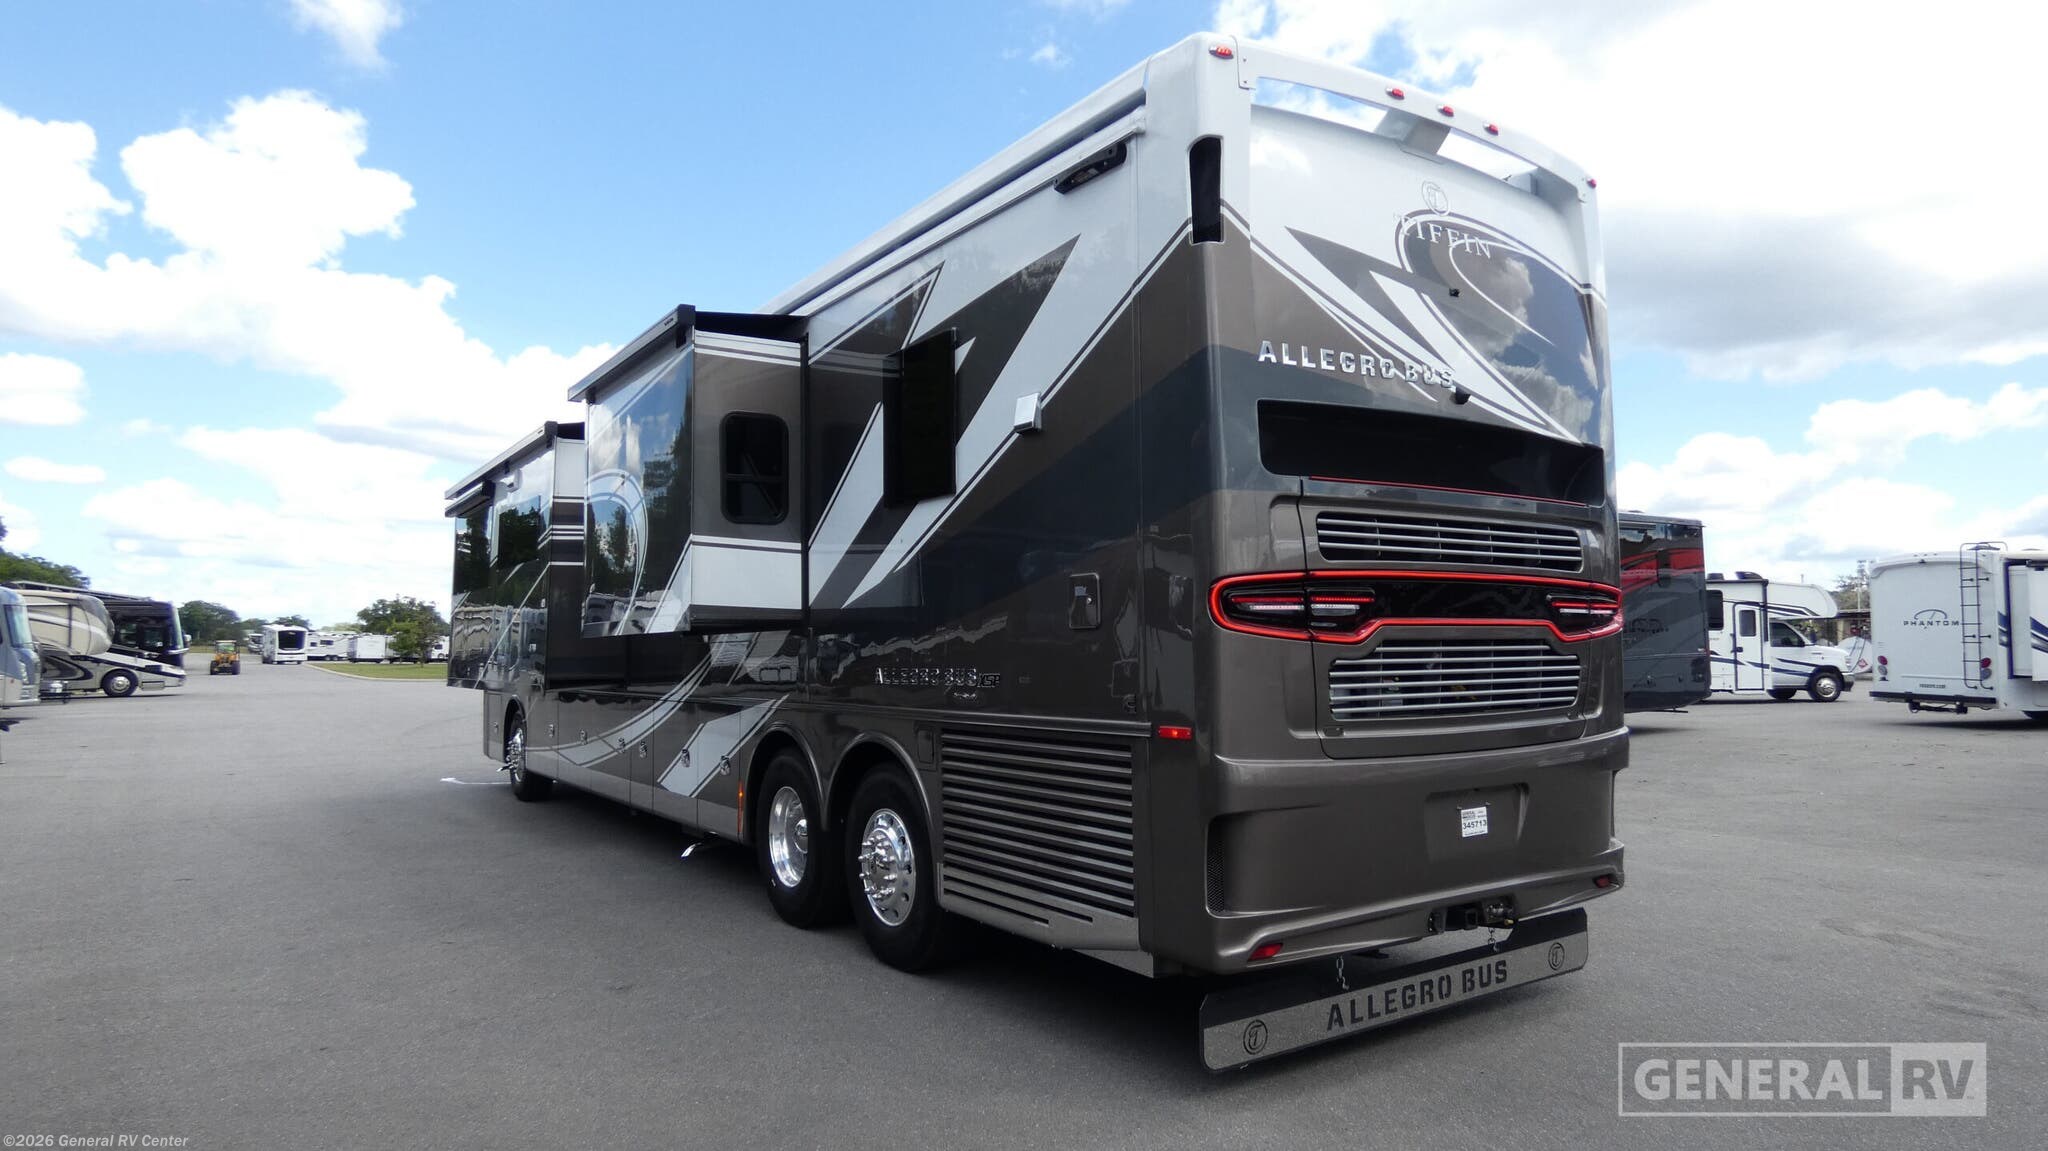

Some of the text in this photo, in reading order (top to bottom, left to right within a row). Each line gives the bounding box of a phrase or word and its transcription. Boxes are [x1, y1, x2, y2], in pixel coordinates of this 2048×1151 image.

[1393, 212, 1491, 259] TIFFIN
[1258, 340, 1457, 389] ALLEGRO BUS
[875, 667, 940, 685] ALLEGRO
[944, 667, 977, 686] BUS
[1326, 959, 1508, 1031] ALLEGRO BUS
